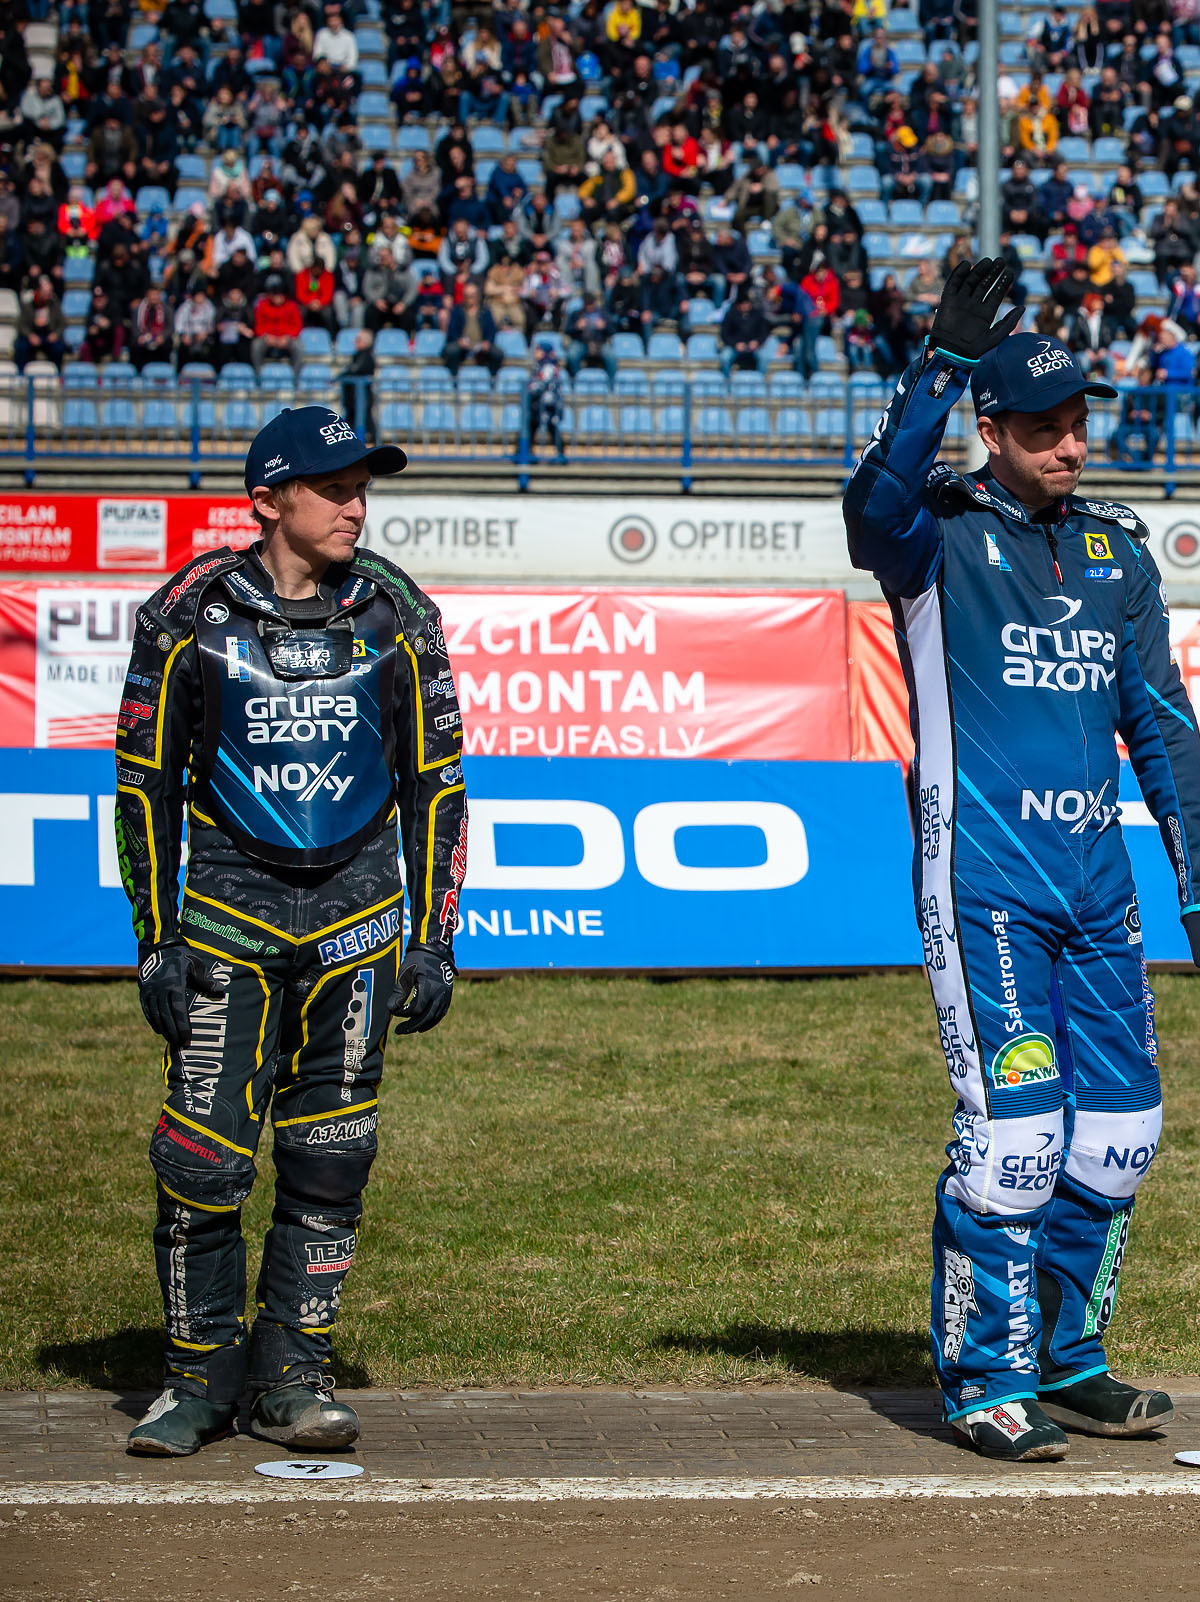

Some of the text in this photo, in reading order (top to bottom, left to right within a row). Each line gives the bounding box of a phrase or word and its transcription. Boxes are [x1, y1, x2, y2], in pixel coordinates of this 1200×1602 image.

[381, 515, 520, 547] OPTIBET
[668, 518, 806, 551] OPTIBET
[318, 907, 400, 966] REFAIR
[991, 910, 1024, 1032] Saletromag
